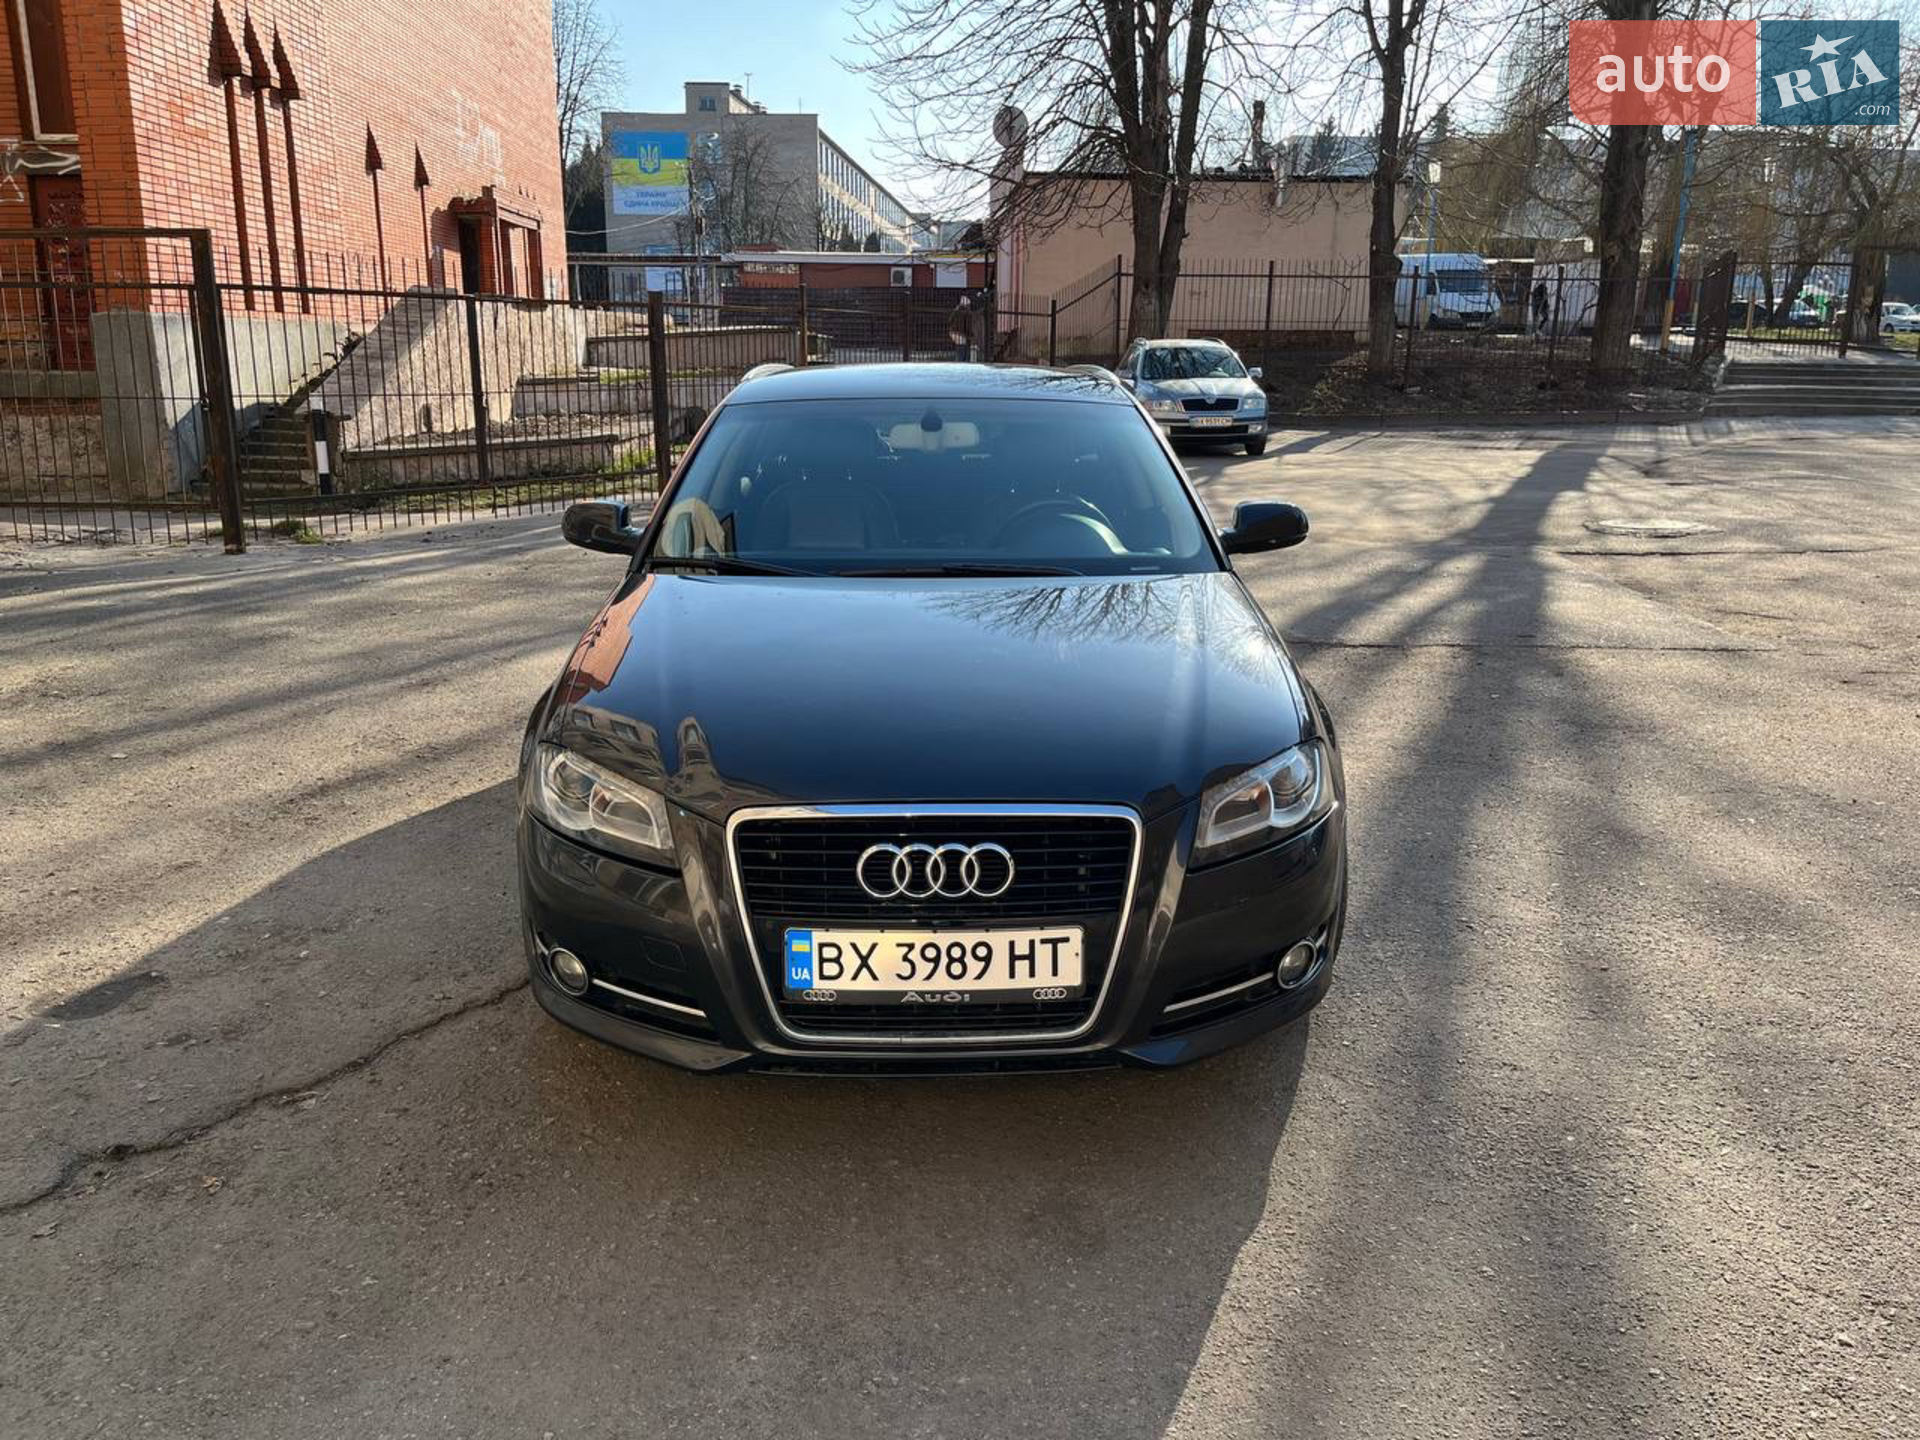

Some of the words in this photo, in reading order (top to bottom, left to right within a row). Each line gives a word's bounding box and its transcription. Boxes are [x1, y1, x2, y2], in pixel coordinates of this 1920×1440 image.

[817, 942, 879, 981] BX
[895, 940, 993, 981] 3989
[1008, 937, 1070, 979] HT
[791, 967, 811, 980] UA
